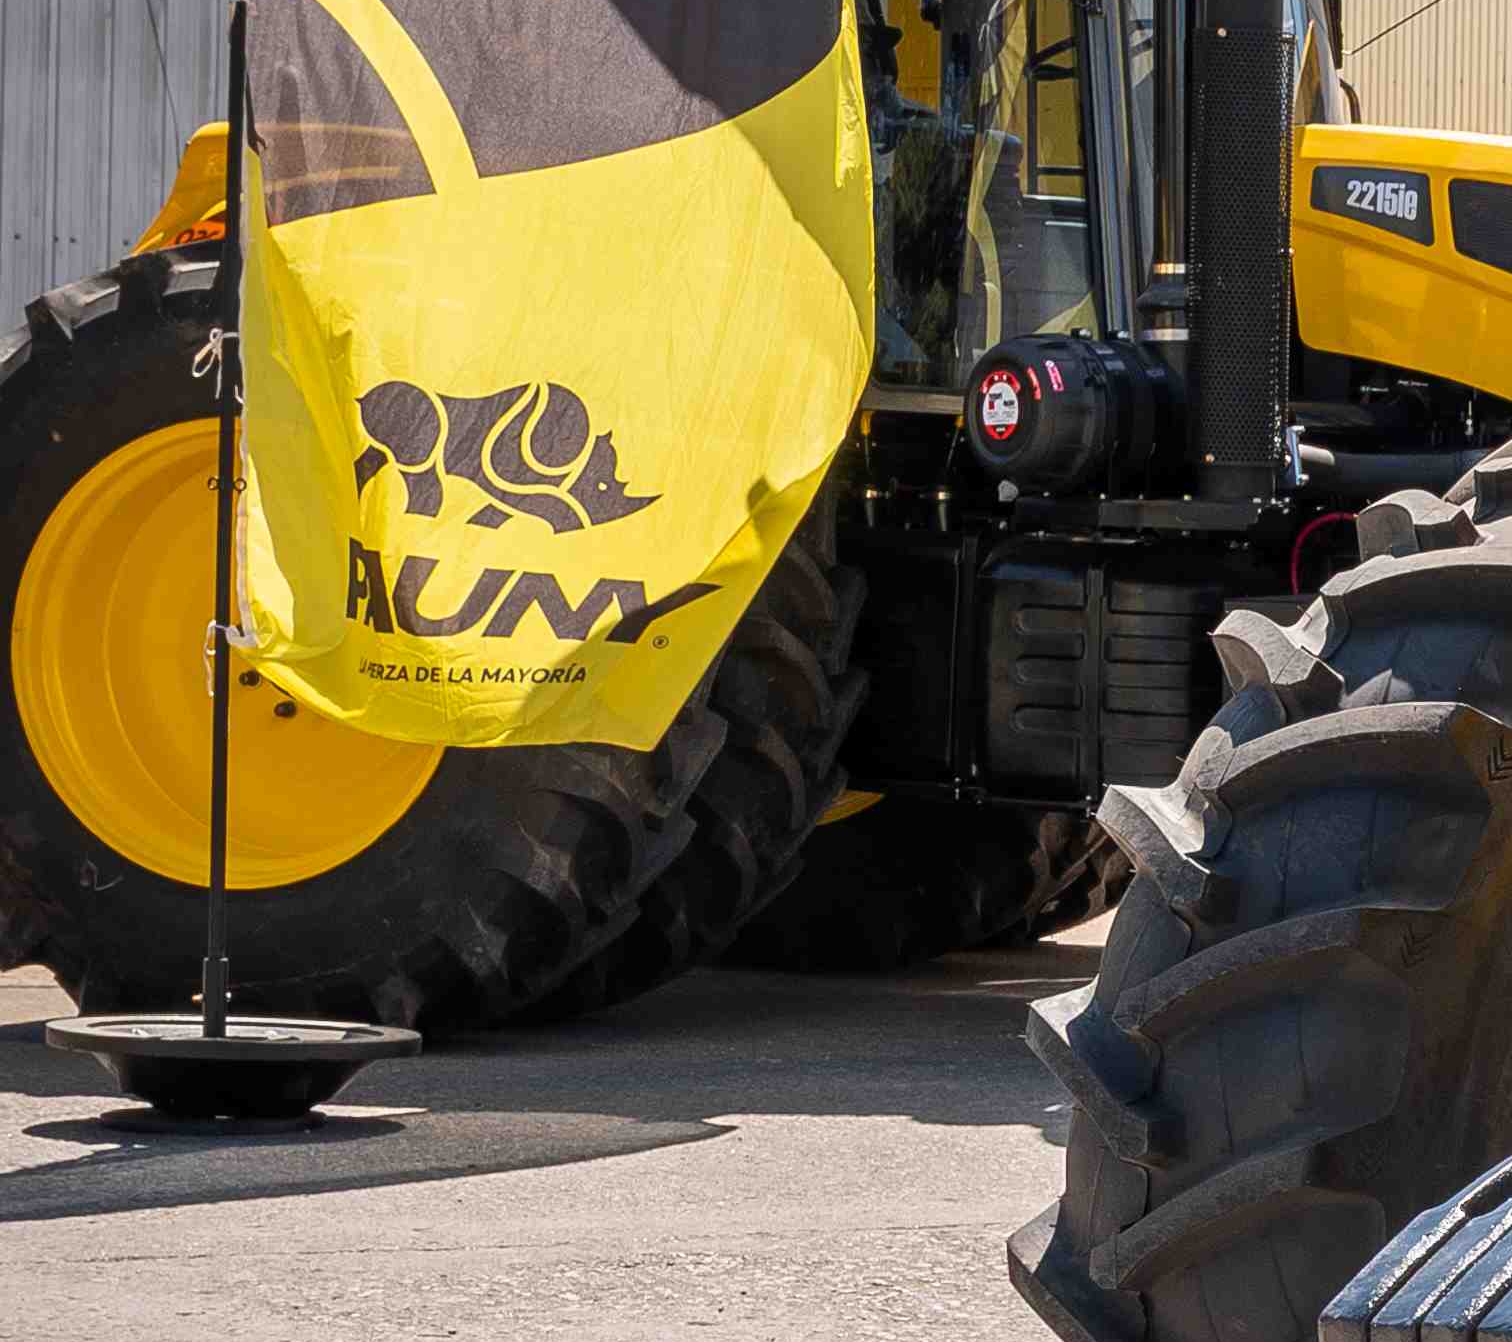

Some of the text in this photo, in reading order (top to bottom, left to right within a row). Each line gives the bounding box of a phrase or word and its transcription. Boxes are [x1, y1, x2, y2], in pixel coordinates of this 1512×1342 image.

[1345, 179, 1418, 221] 2215ie
[345, 532, 723, 644] PAUNY
[415, 665, 442, 683] DE
[447, 665, 473, 684] LA
[480, 662, 587, 684] MAYORÍA
